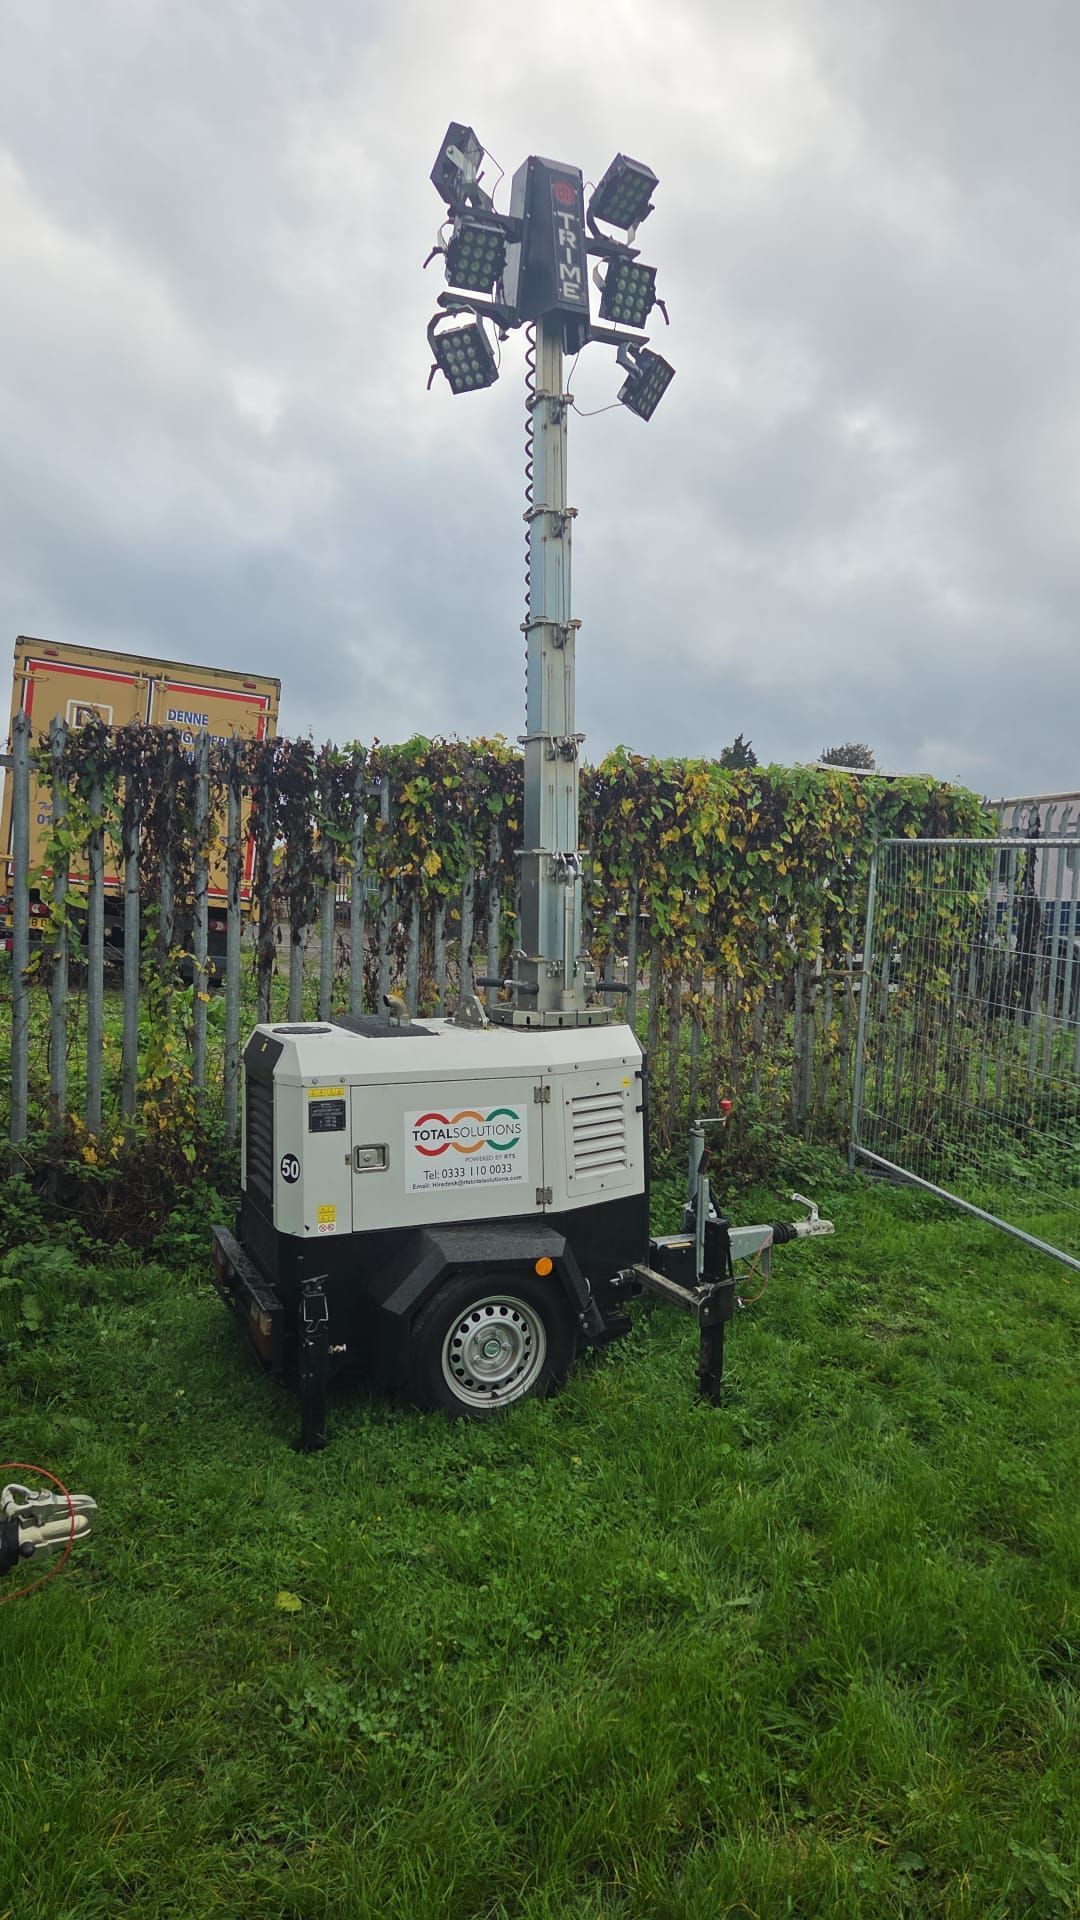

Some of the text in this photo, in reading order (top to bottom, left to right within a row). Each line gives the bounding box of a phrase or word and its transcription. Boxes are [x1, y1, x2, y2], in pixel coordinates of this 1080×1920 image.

[557, 210, 581, 300] TRIME
[167, 709, 209, 727] DENNE
[282, 1159, 299, 1179] 50
[423, 1163, 512, 1180] Tel: 0333 110 0033
[412, 1182, 431, 1190] Email:
